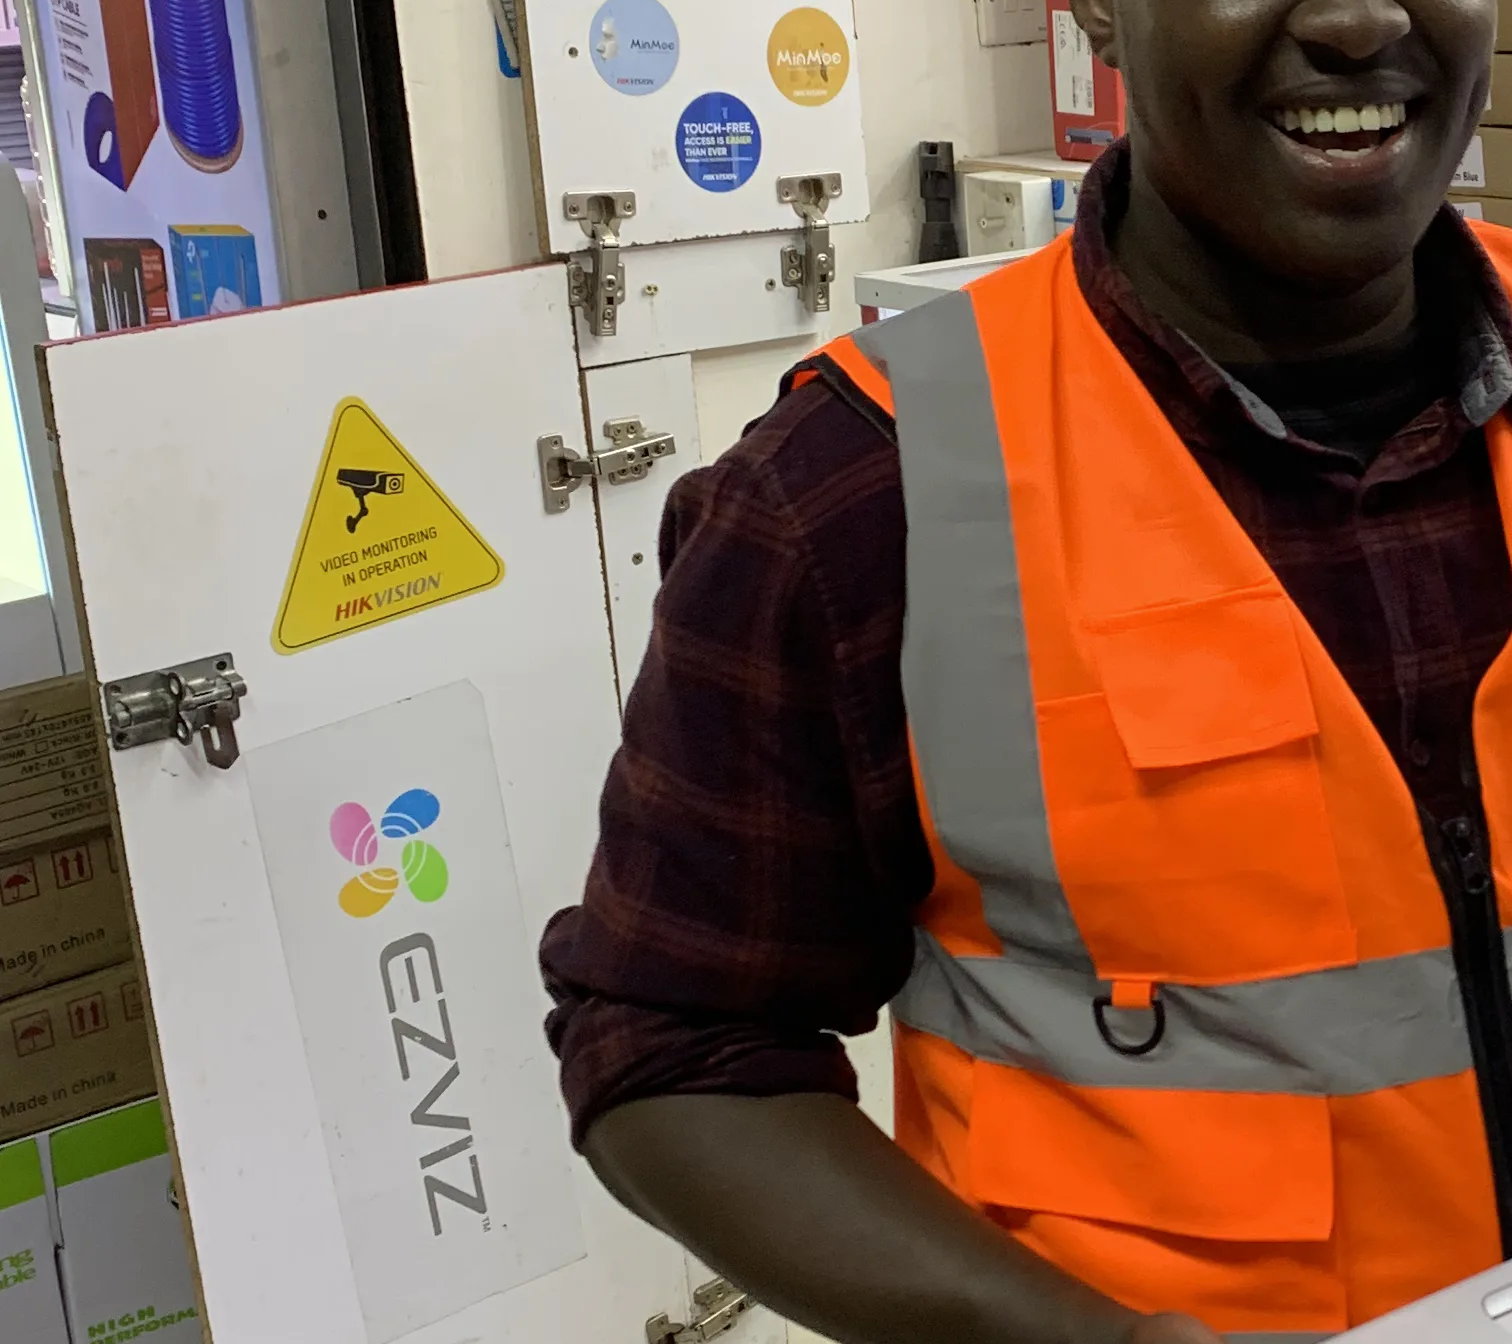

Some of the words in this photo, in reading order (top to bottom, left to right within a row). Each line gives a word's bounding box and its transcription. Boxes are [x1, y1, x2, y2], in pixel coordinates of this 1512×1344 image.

[631, 38, 675, 50] MinMoe
[777, 50, 842, 67] MinMoe
[617, 78, 654, 86] HIKVISION
[684, 122, 754, 135] TOUCH-FREE,
[684, 136, 715, 146] ACCESS
[717, 136, 725, 145] IS
[726, 135, 752, 145] EASIER
[685, 147, 706, 157] THAN
[708, 147, 728, 156] EVER
[702, 174, 737, 182] HIKVISION
[320, 551, 359, 573] VIDEO
[362, 526, 438, 561] MONITORING
[342, 572, 356, 587] IN
[359, 550, 428, 582] OPERATION
[334, 572, 442, 622] HIKVISION
[378, 930, 488, 1238] EZVIZ
[1, 1093, 48, 1120] Made
[53, 1088, 68, 1103] in
[72, 1072, 118, 1097] china
